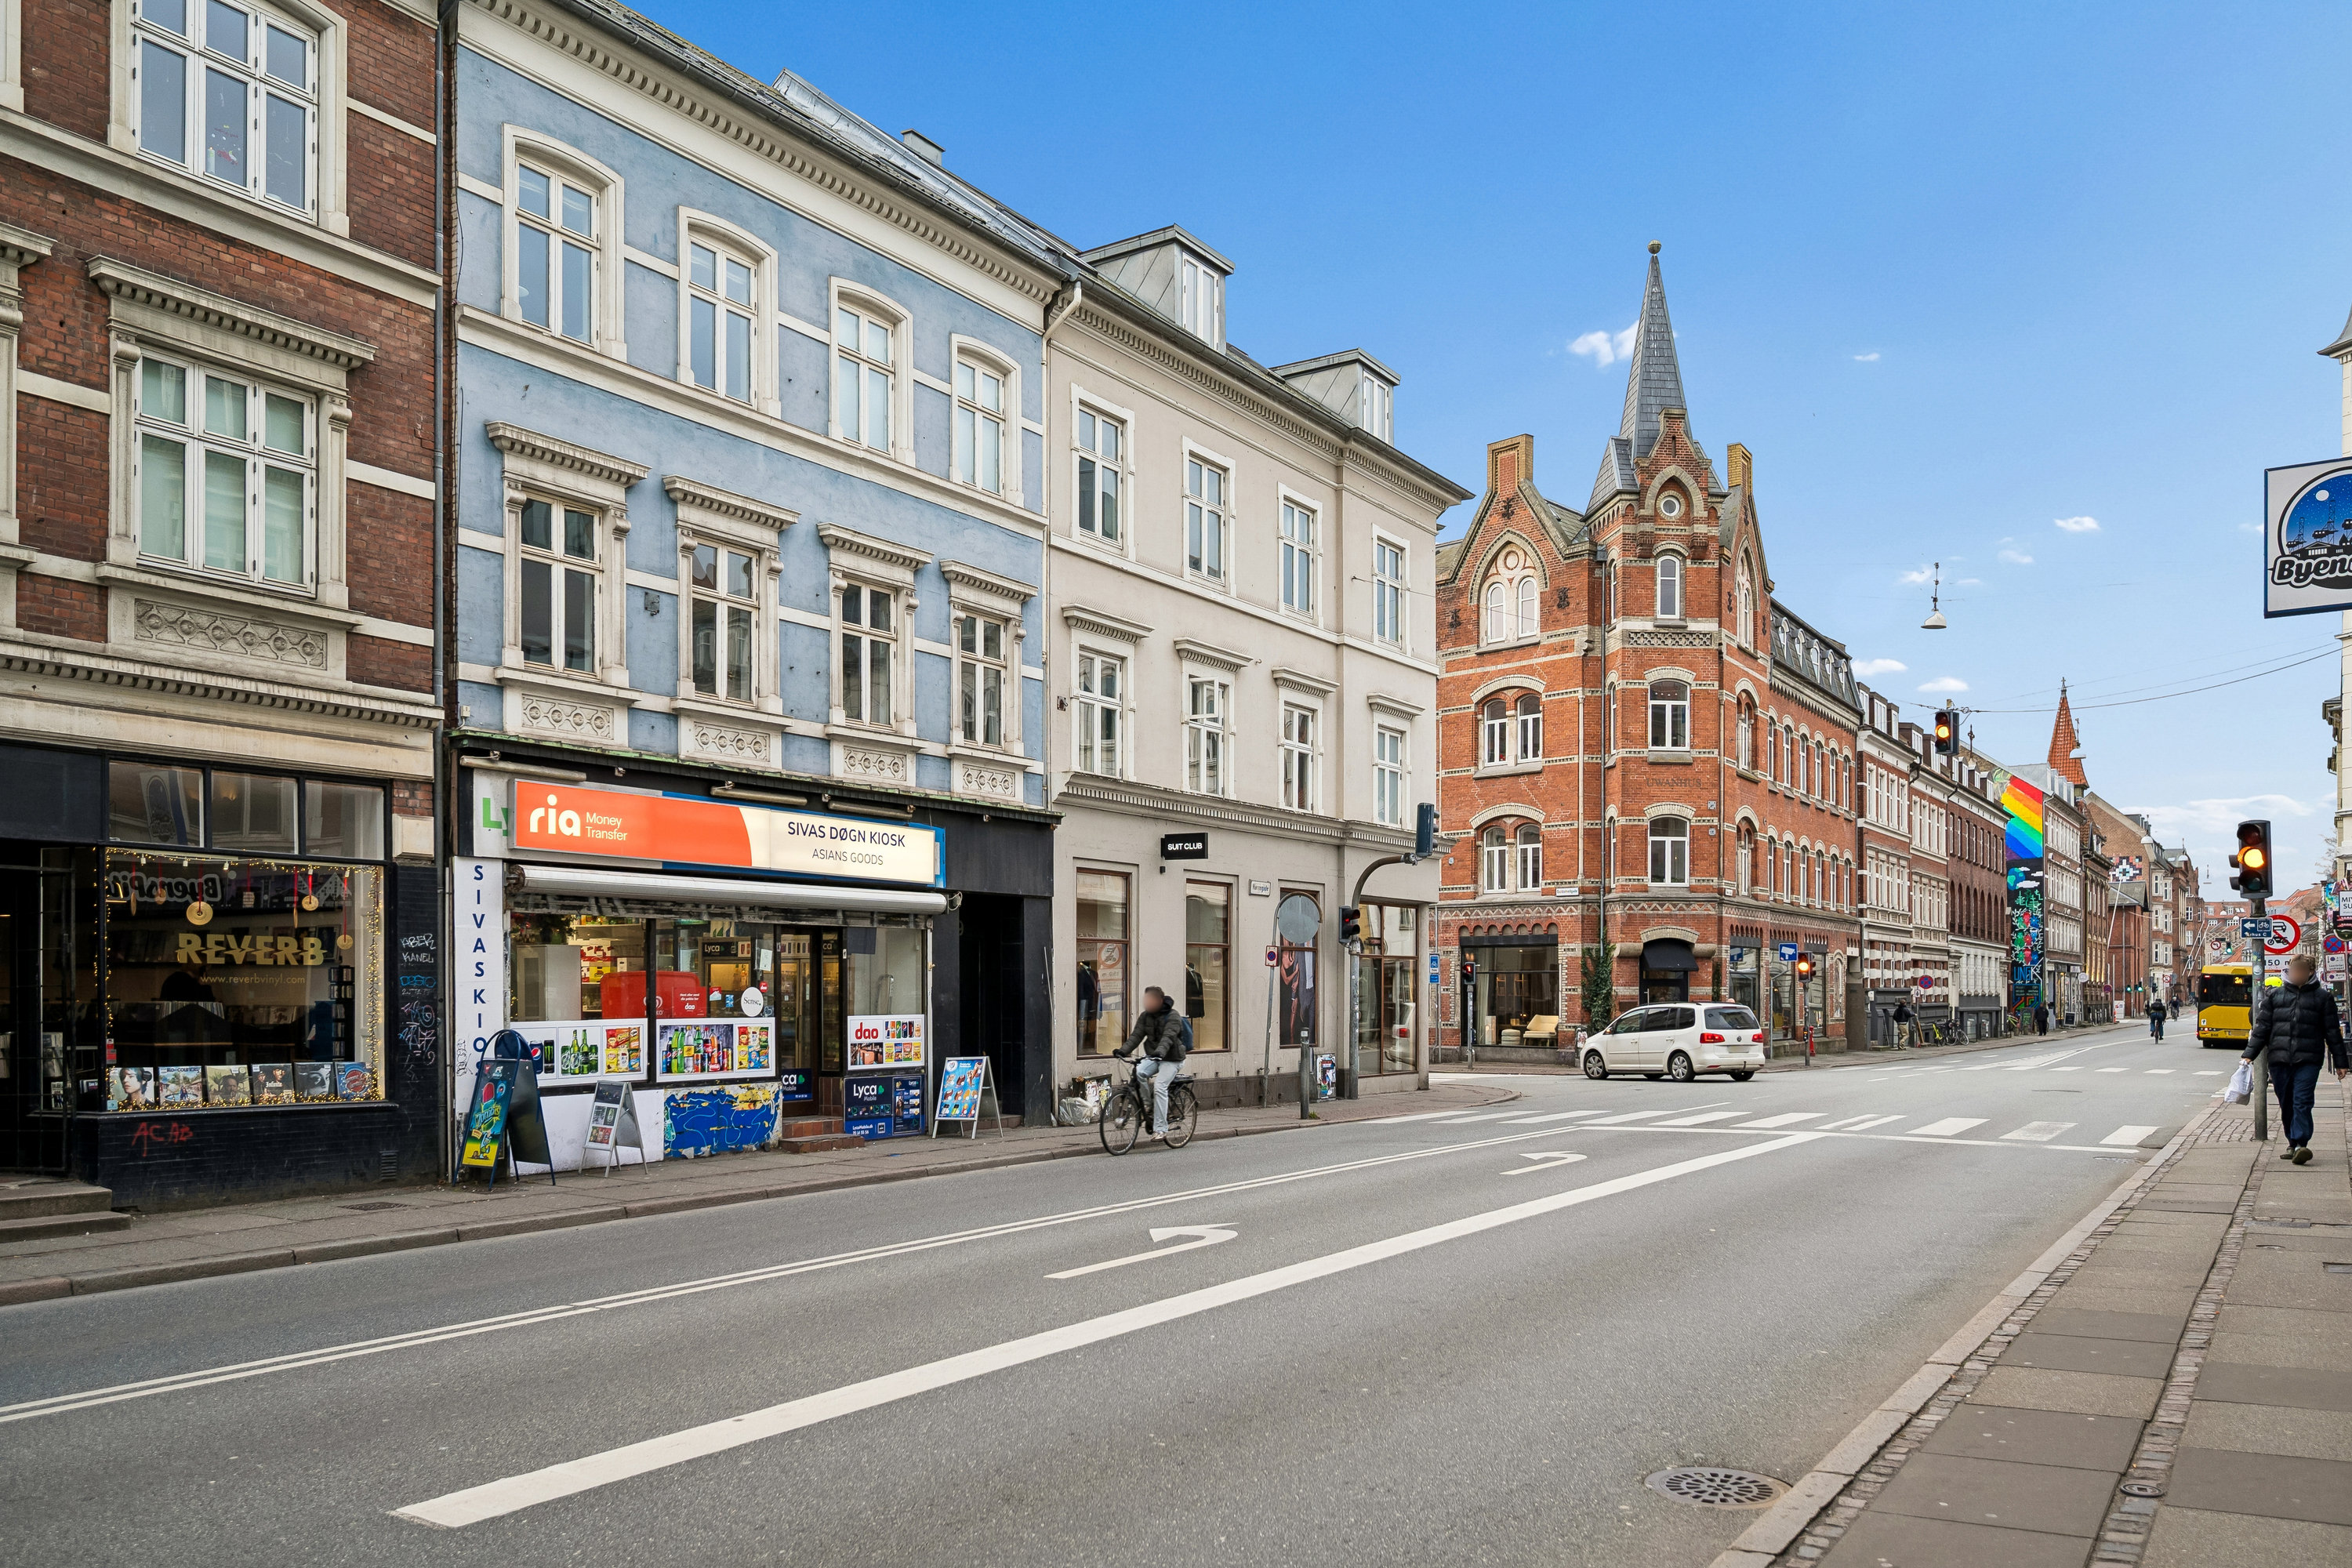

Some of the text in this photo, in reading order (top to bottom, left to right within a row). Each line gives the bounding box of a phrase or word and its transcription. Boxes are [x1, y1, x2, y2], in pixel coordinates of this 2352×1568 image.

[529, 794, 581, 837] ria
[586, 812, 622, 829] Money
[586, 826, 628, 841] Transfer
[788, 822, 906, 848] SIVAS DØGN KIOSK
[812, 848, 884, 866] ASIANS GOODS
[472, 865, 487, 978] SIVAS
[176, 933, 328, 966] REVERB
[704, 944, 720, 953] Lyca
[200, 973, 306, 985] www.reverbvinyl.com
[855, 1022, 878, 1040] dao
[782, 1074, 797, 1085] ca
[854, 1084, 877, 1098] Lyca
